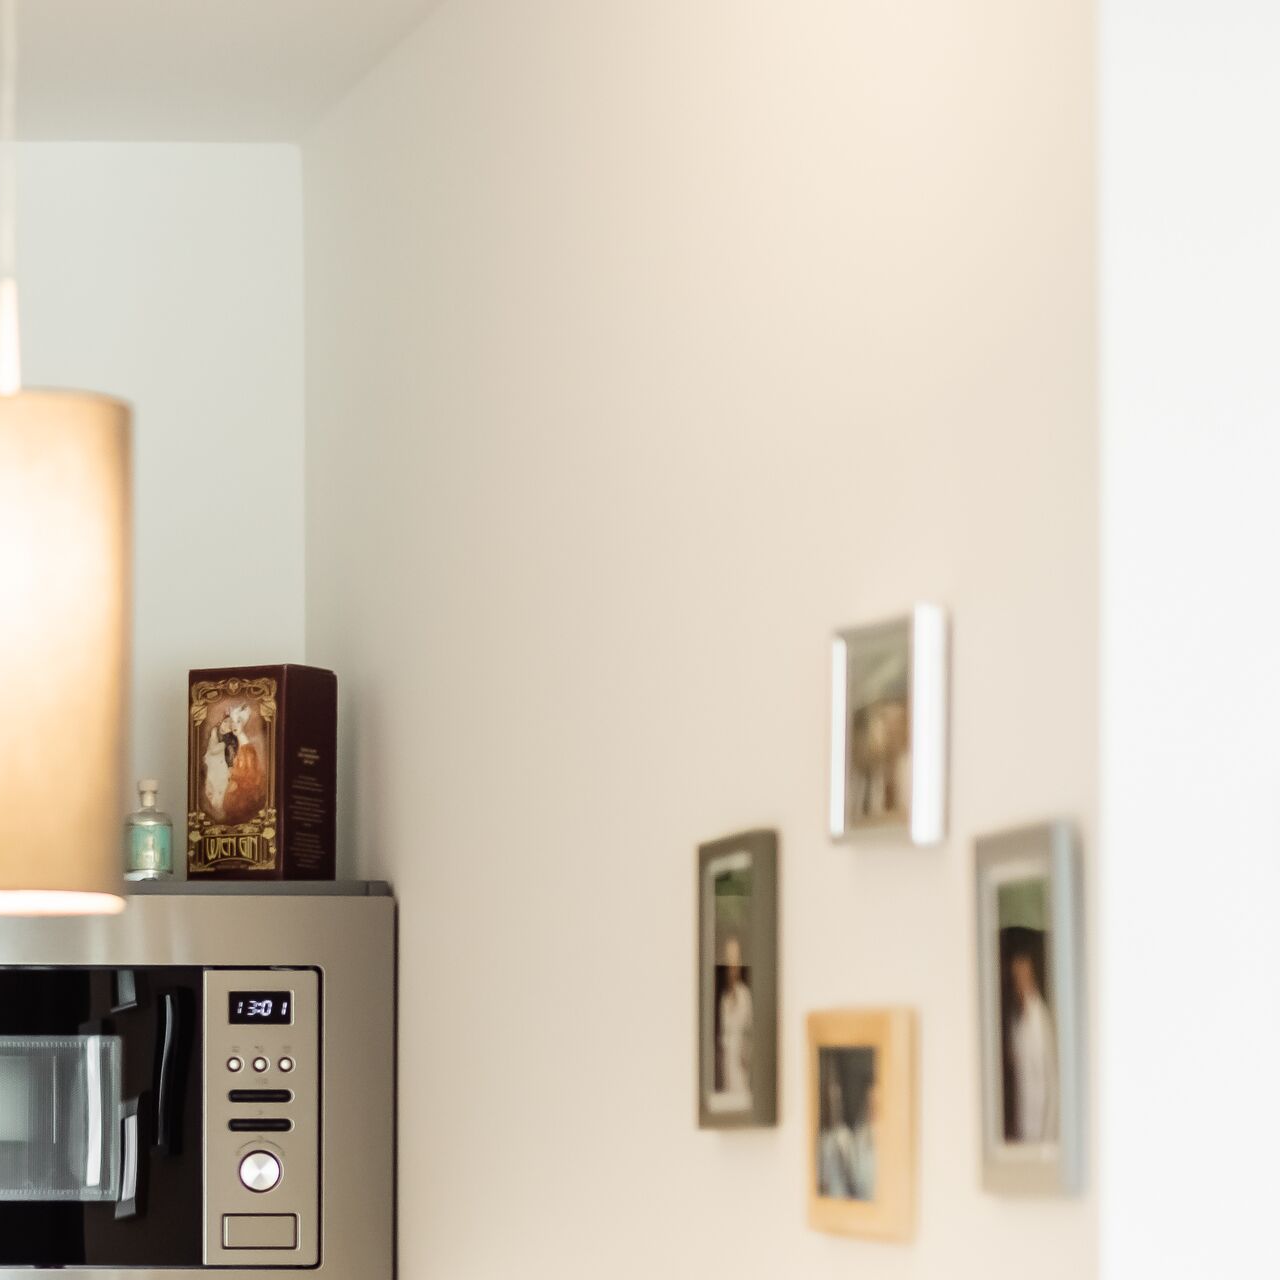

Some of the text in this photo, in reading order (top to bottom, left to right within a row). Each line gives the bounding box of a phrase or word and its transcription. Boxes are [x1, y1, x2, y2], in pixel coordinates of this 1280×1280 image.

[205, 836, 258, 861] WIEN GIN
[237, 1000, 288, 1017] 13:01
